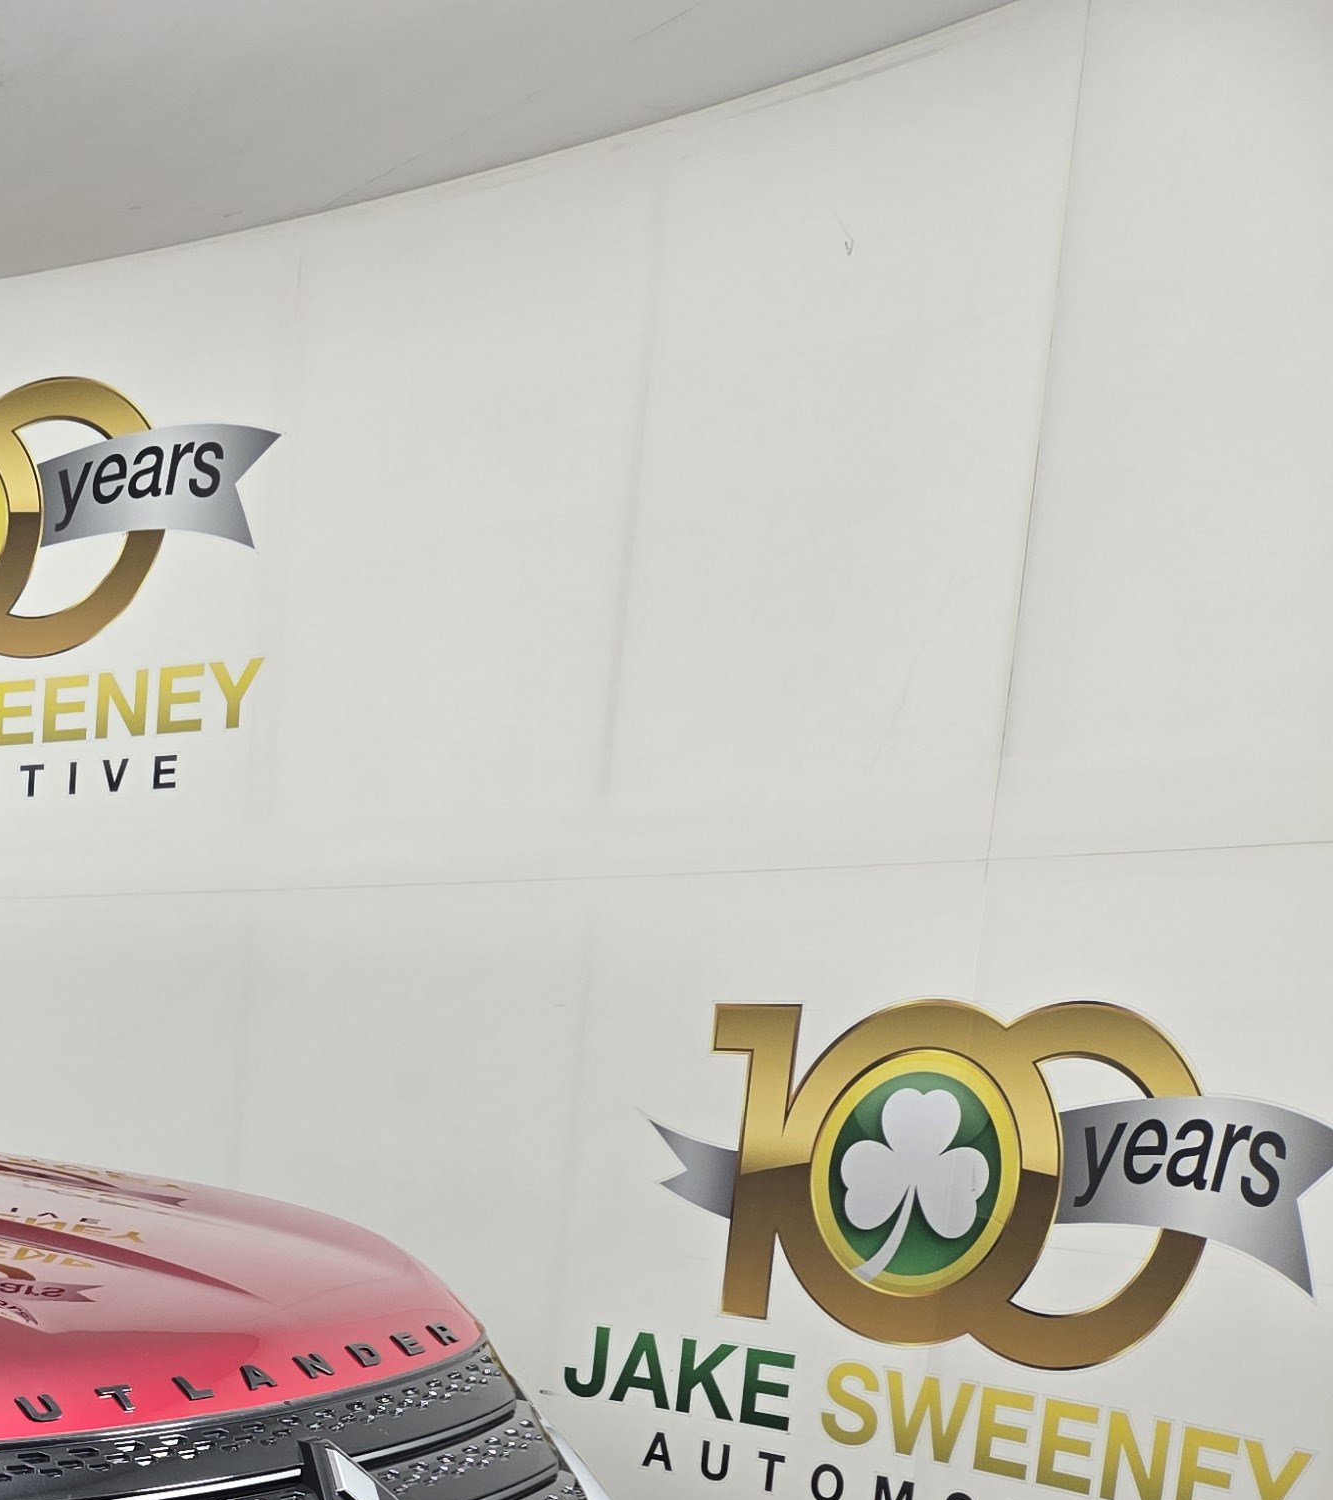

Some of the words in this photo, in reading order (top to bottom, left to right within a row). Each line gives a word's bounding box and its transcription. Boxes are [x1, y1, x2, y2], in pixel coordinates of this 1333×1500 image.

[53, 440, 225, 532] years
[712, 998, 1208, 1371] 100
[1073, 1114, 1289, 1208] years
[563, 1325, 796, 1432] JAKE
